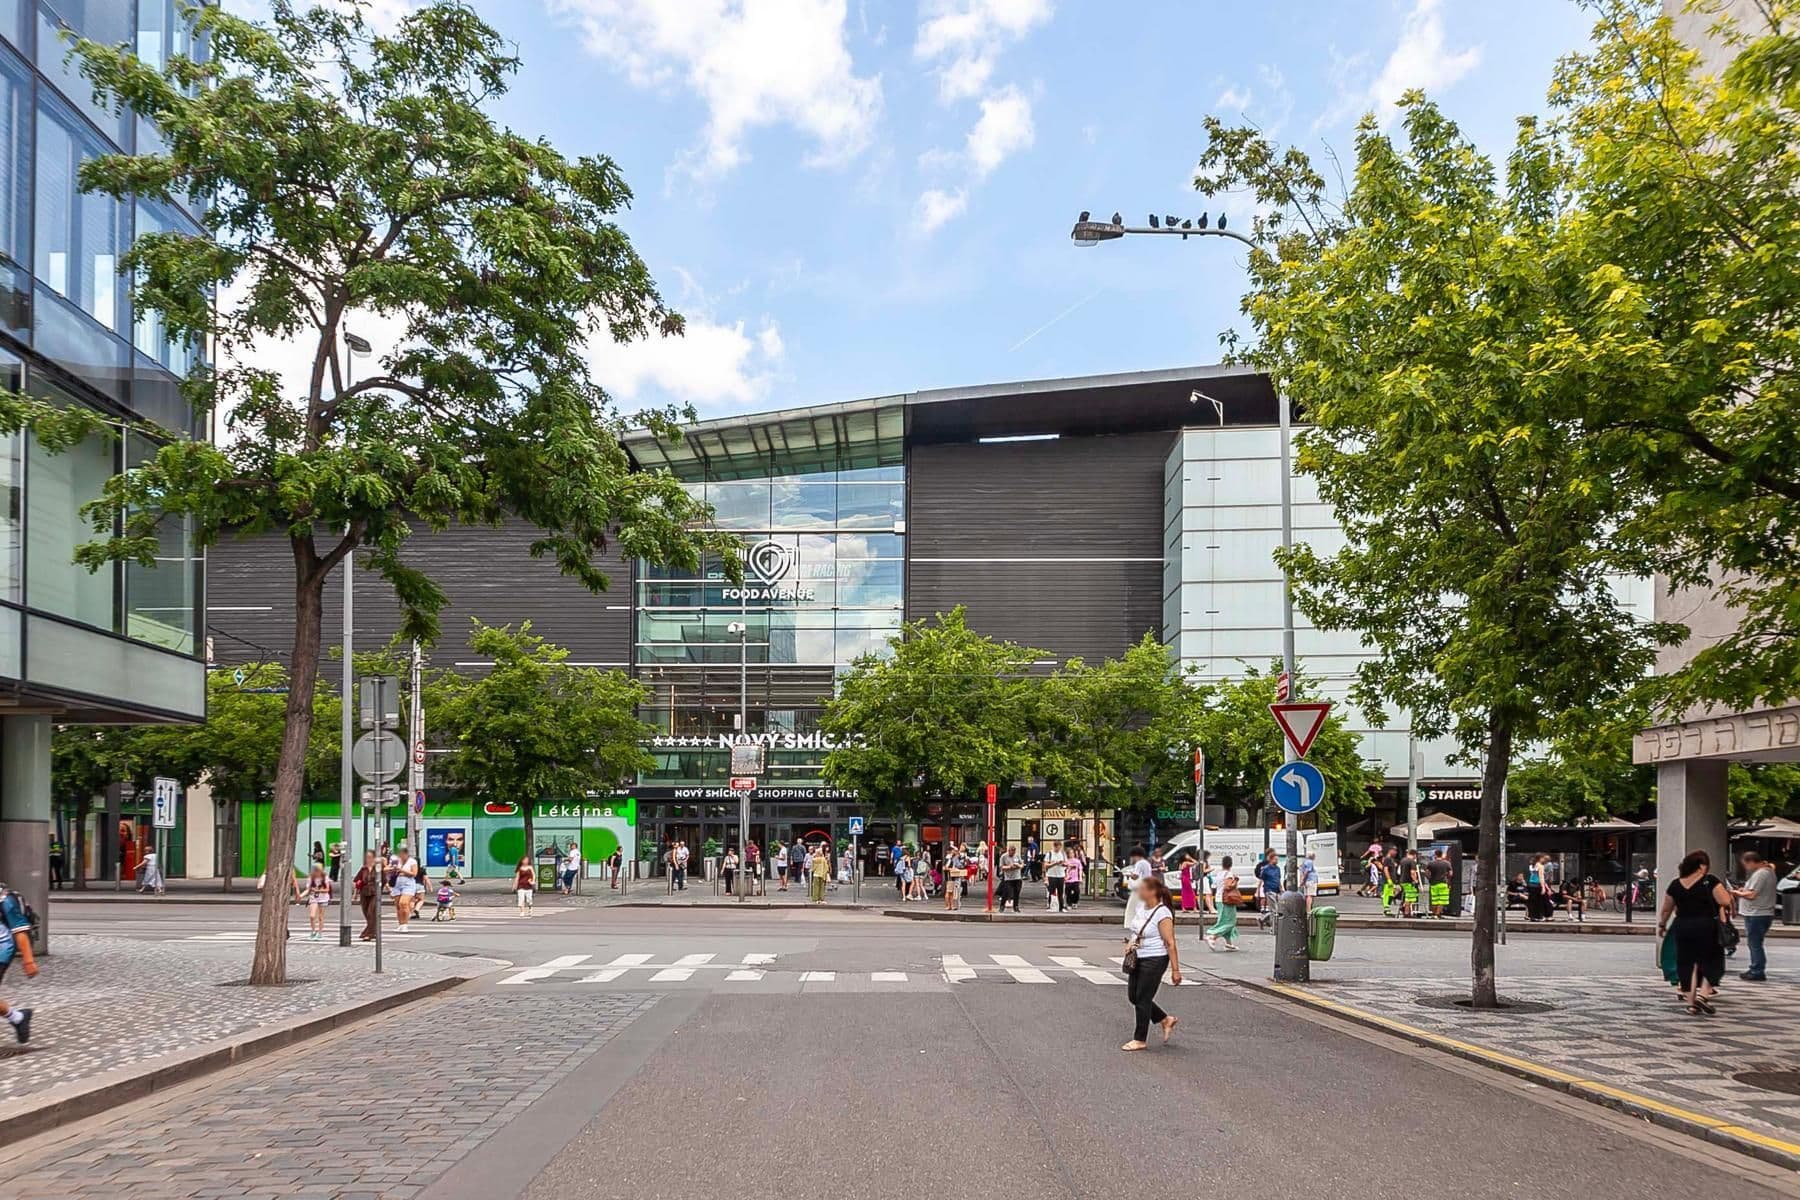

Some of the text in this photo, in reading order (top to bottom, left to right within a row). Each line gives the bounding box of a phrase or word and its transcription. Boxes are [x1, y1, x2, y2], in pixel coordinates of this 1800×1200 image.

[722, 588, 815, 600] FOOD AVENUE
[719, 730, 779, 749] NOVÝ
[675, 787, 703, 798] NOVÝ
[757, 789, 814, 798] SHOPPING
[817, 788, 860, 798] CENTER
[538, 805, 613, 817] Lékárna
